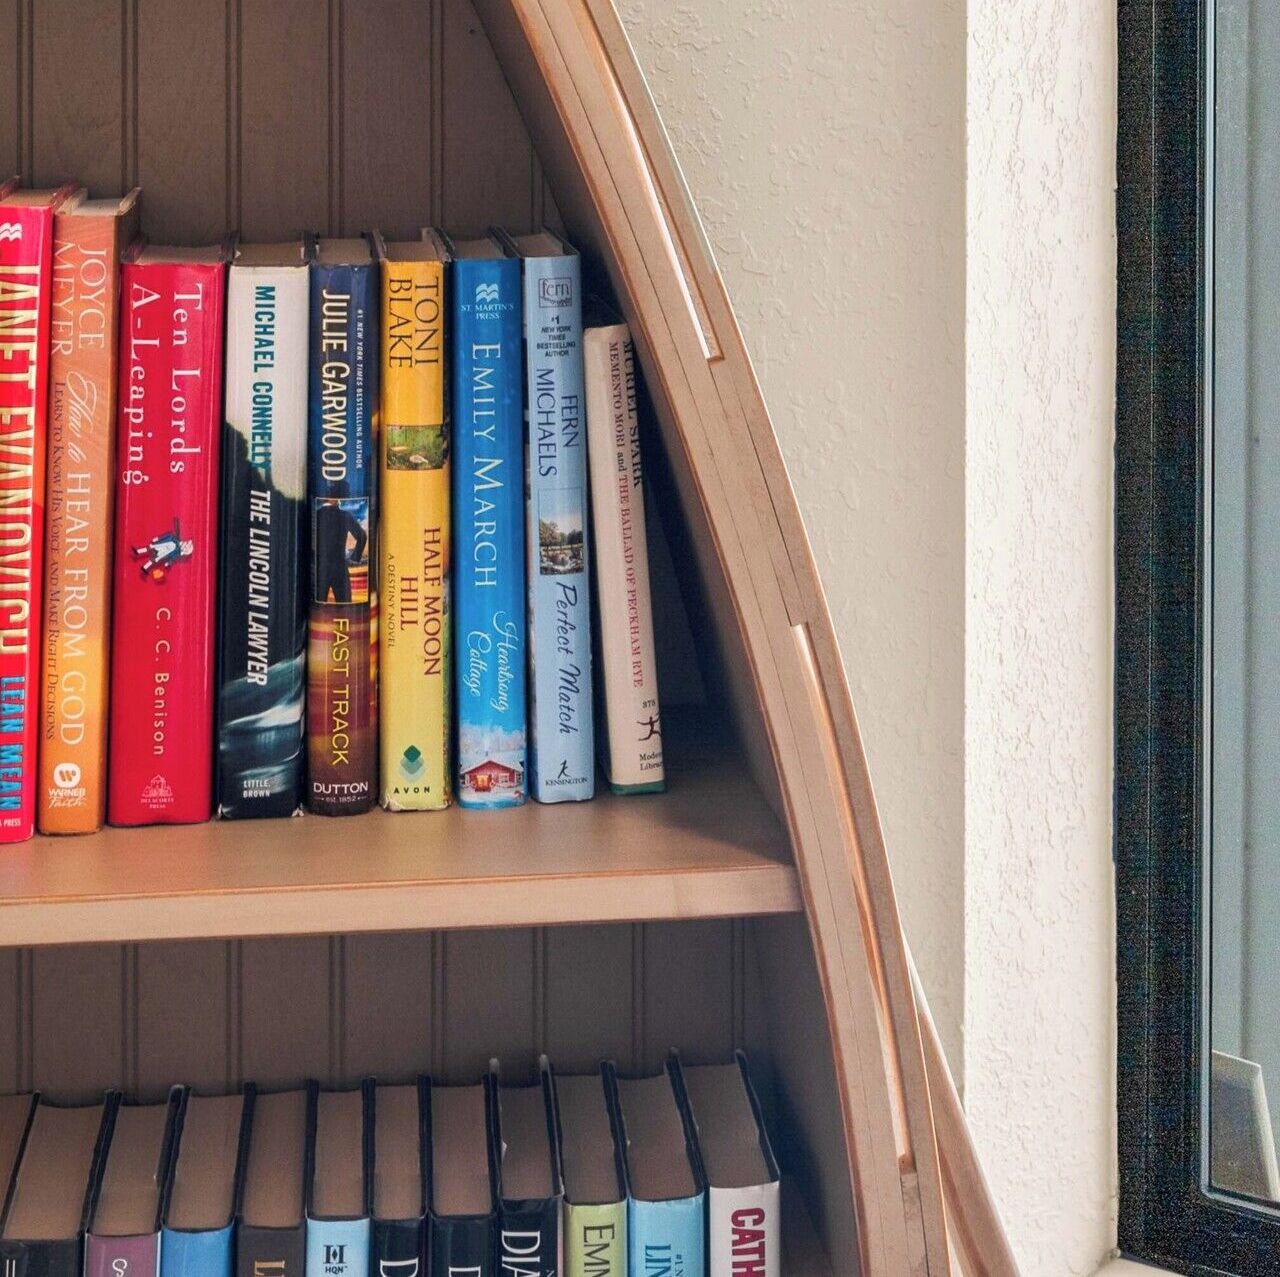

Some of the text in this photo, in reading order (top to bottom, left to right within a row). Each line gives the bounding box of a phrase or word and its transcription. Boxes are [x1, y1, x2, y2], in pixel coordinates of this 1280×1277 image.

[51, 239, 76, 355] MEYER
[78, 244, 107, 349] JOYCE
[543, 279, 569, 297] fern
[356, 322, 364, 339] NEW
[389, 278, 412, 368] BLAKE
[414, 276, 440, 365] TONI
[536, 341, 576, 350] BESTSELLING
[556, 325, 571, 333] YORK
[170, 282, 203, 473] Ten Lords
[251, 285, 276, 472] MICHAEL CONNELLY
[356, 341, 364, 362] YORK
[356, 363, 364, 387] TIMES
[54, 382, 66, 423] LEARN
[123, 282, 161, 485] A-Leaping
[321, 289, 351, 482] JULIE GARWOOD
[53, 425, 64, 442] TO
[536, 368, 558, 477] MICHAELS
[561, 395, 579, 449] FERN
[623, 339, 643, 489] MURIEL SPARK
[52, 445, 64, 485] KNOW
[473, 342, 504, 587] EMILY MARCH
[52, 489, 63, 513] HIS
[609, 342, 644, 688] MEMENTO MORI and THE BALLAD OF PECKHAM RYE
[51, 515, 63, 553] VOICE
[60, 370, 97, 745] How to HEAR FROM GOD
[48, 590, 61, 628] MAKE
[247, 490, 271, 686] THE LINCOLN LAWYER
[386, 553, 395, 649] A DESTINY NOVEL
[400, 576, 418, 631] HILL
[423, 527, 441, 676] HALF MOON
[48, 629, 60, 671] RIGHT
[463, 630, 492, 697] Cottage
[491, 610, 519, 714] Heartsong
[555, 581, 580, 734] Perfect Match
[0, 675, 26, 734] LEAN
[46, 673, 59, 741] DECISIONS
[153, 607, 172, 755] C. C. Benison
[331, 618, 349, 766] FAST TRACK
[48, 788, 86, 797] WARNER
[242, 789, 271, 798] BROWN
[313, 781, 369, 794] DUTTON
[338, 795, 357, 803] 1852
[394, 786, 430, 794] AVON
[545, 777, 588, 786] KENSINGTON
[3, 818, 21, 827] PRESS
